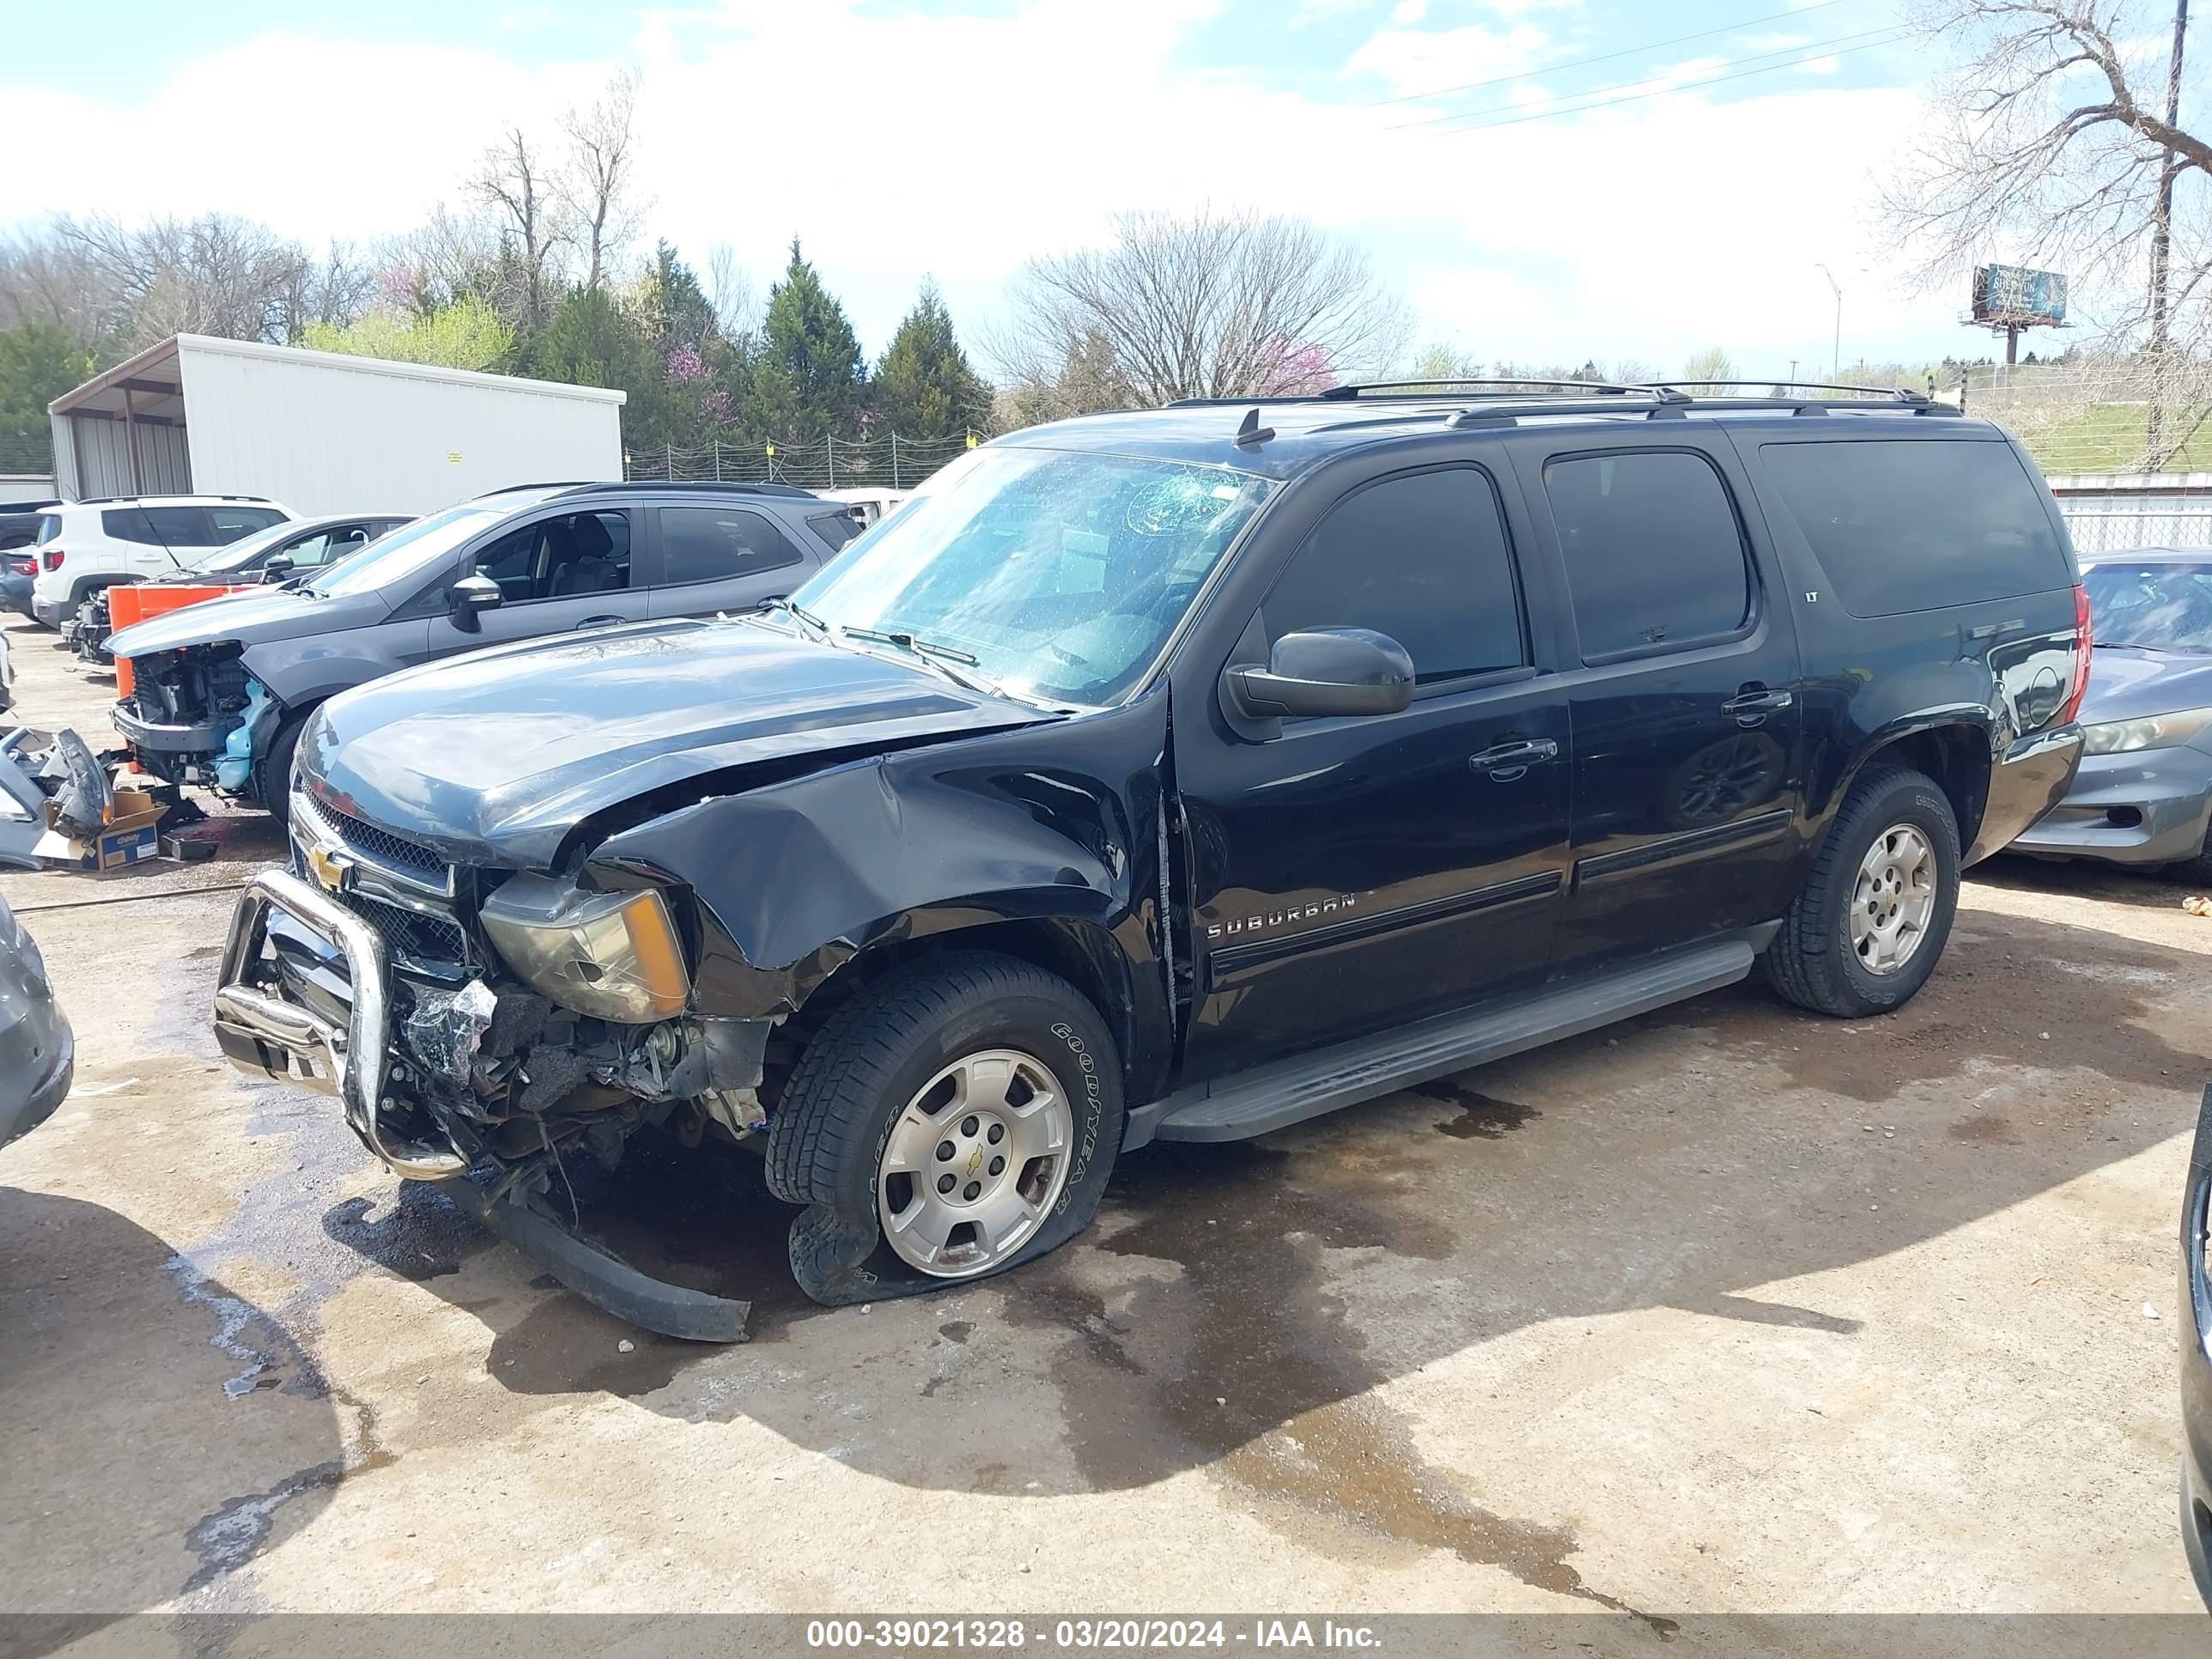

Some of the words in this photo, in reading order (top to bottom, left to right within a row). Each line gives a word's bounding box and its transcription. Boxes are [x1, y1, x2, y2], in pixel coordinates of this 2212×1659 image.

[1805, 592, 1818, 603] LT
[1207, 893, 1356, 939] SUBURBAN
[1051, 1023, 1102, 1215] GOODYEAR
